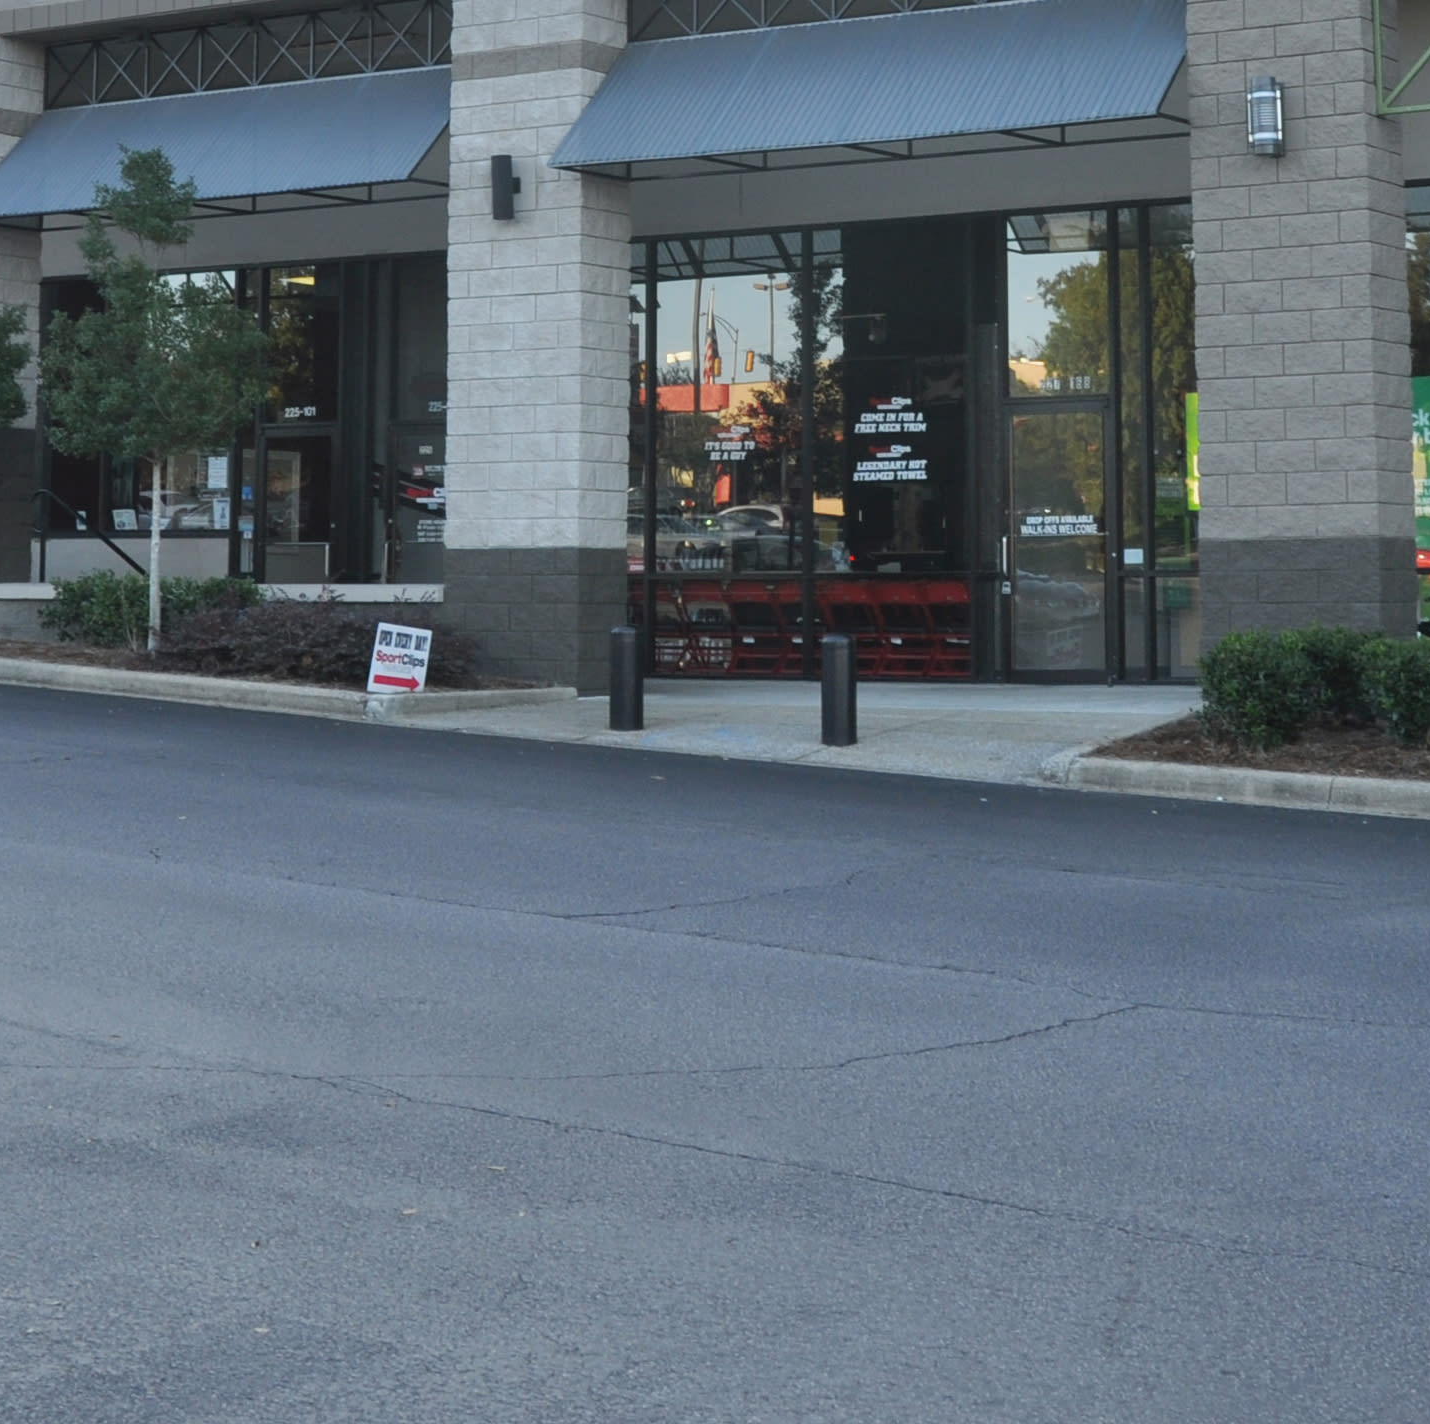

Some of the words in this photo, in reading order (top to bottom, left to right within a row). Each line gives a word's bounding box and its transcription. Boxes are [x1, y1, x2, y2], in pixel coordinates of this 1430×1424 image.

[284, 406, 316, 418] 225-101
[853, 471, 895, 481] STEAMED
[896, 470, 928, 480] TOWEL
[1060, 515, 1094, 523] AVAILABLE
[1058, 524, 1098, 534] WELCOME
[375, 650, 426, 669] SportClips
